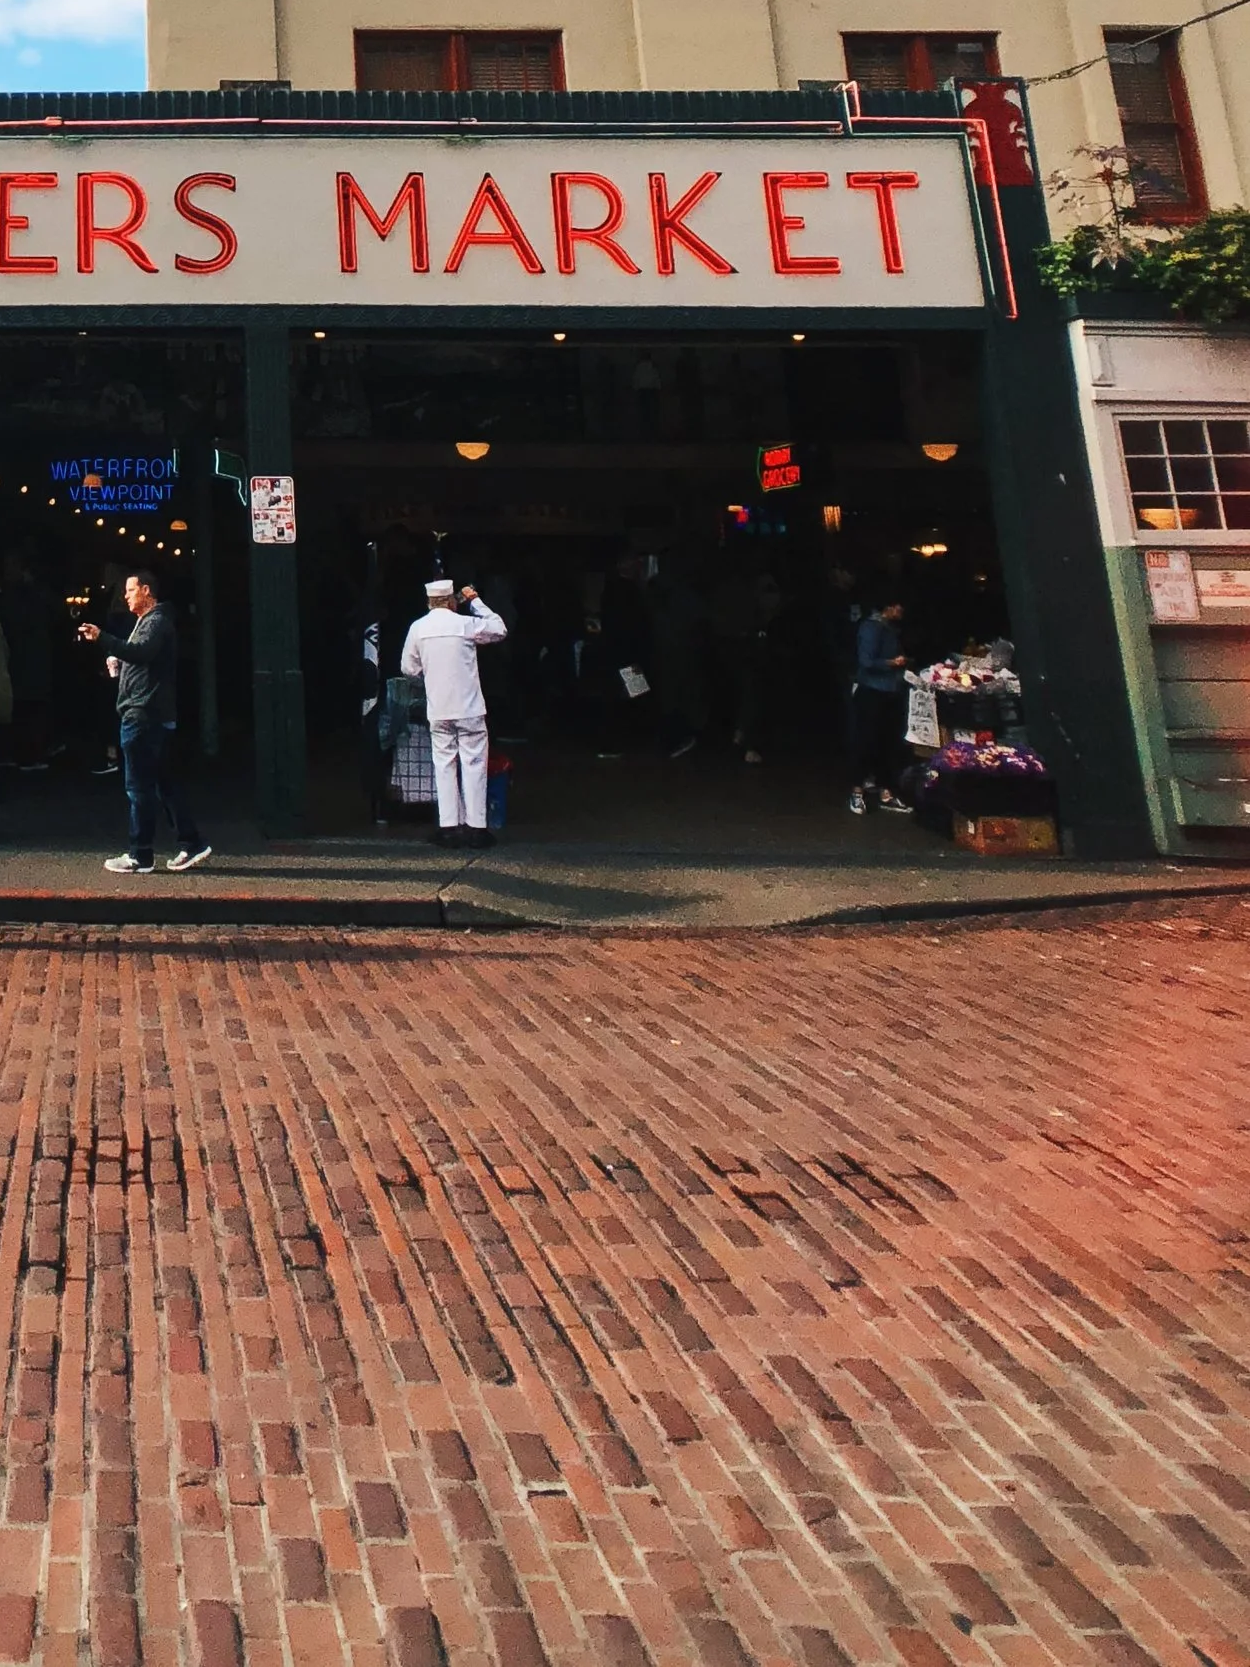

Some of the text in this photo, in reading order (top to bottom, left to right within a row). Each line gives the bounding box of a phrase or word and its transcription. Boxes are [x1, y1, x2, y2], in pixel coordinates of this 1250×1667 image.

[336, 171, 919, 274] MARKET
[50, 458, 175, 480] WATERFRON
[70, 484, 174, 501] VIEWPOINT
[92, 503, 121, 511] PUBLIC
[123, 502, 158, 510] SEATING
